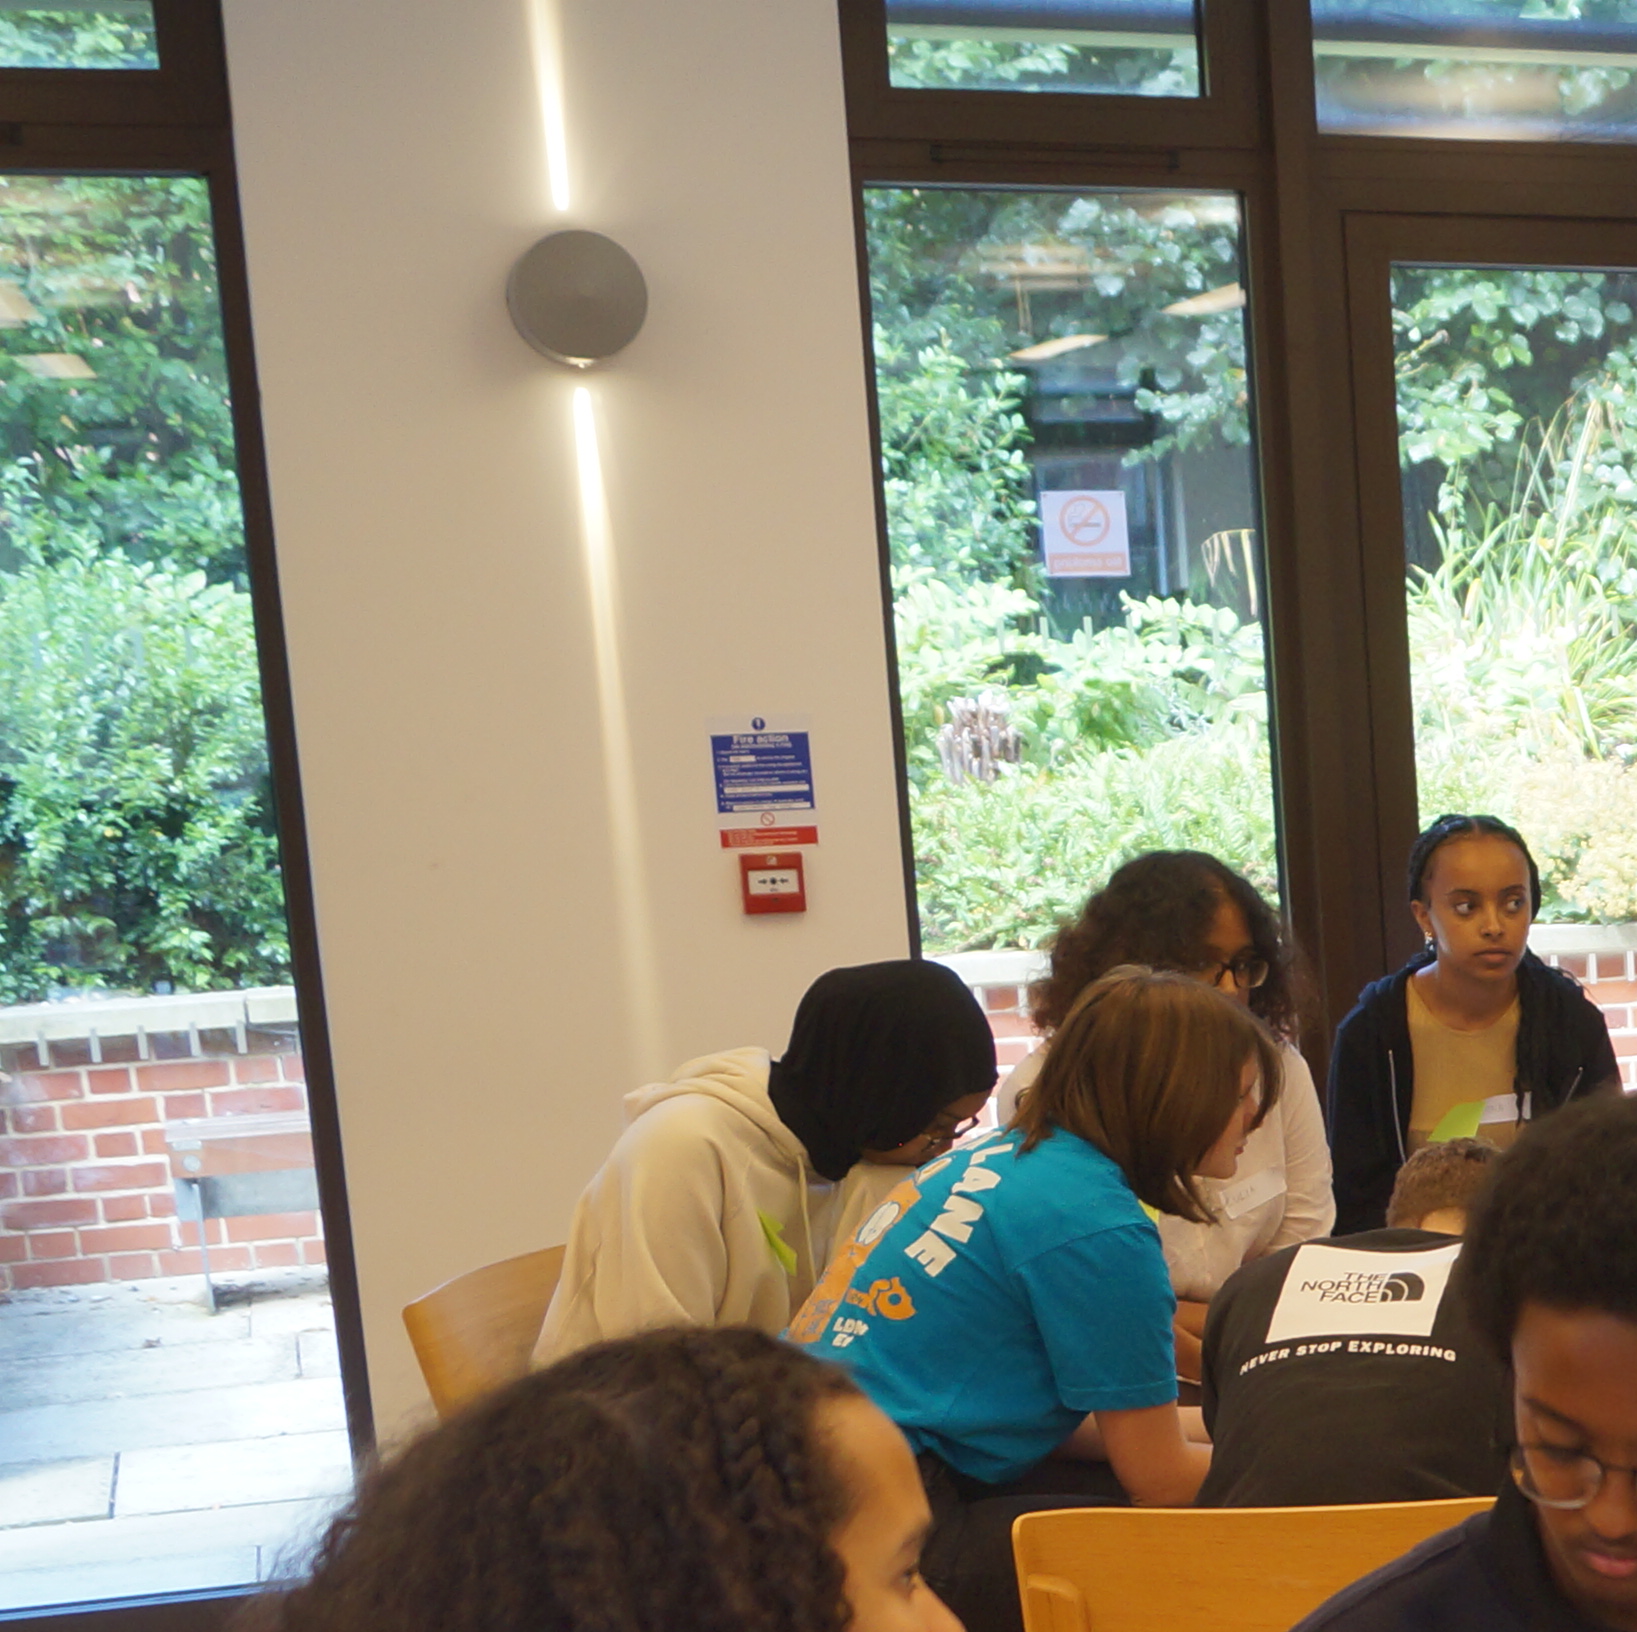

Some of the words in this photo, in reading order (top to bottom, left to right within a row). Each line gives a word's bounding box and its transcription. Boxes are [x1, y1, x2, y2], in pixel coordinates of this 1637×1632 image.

[905, 1142, 1015, 1278] LANE
[1343, 1272, 1388, 1282] THE
[1300, 1280, 1386, 1292] NORTH
[1319, 1291, 1380, 1304] FACE
[1239, 1348, 1291, 1376] NEVER
[1295, 1341, 1342, 1357] STOP
[1348, 1340, 1457, 1363] EXPLORING
